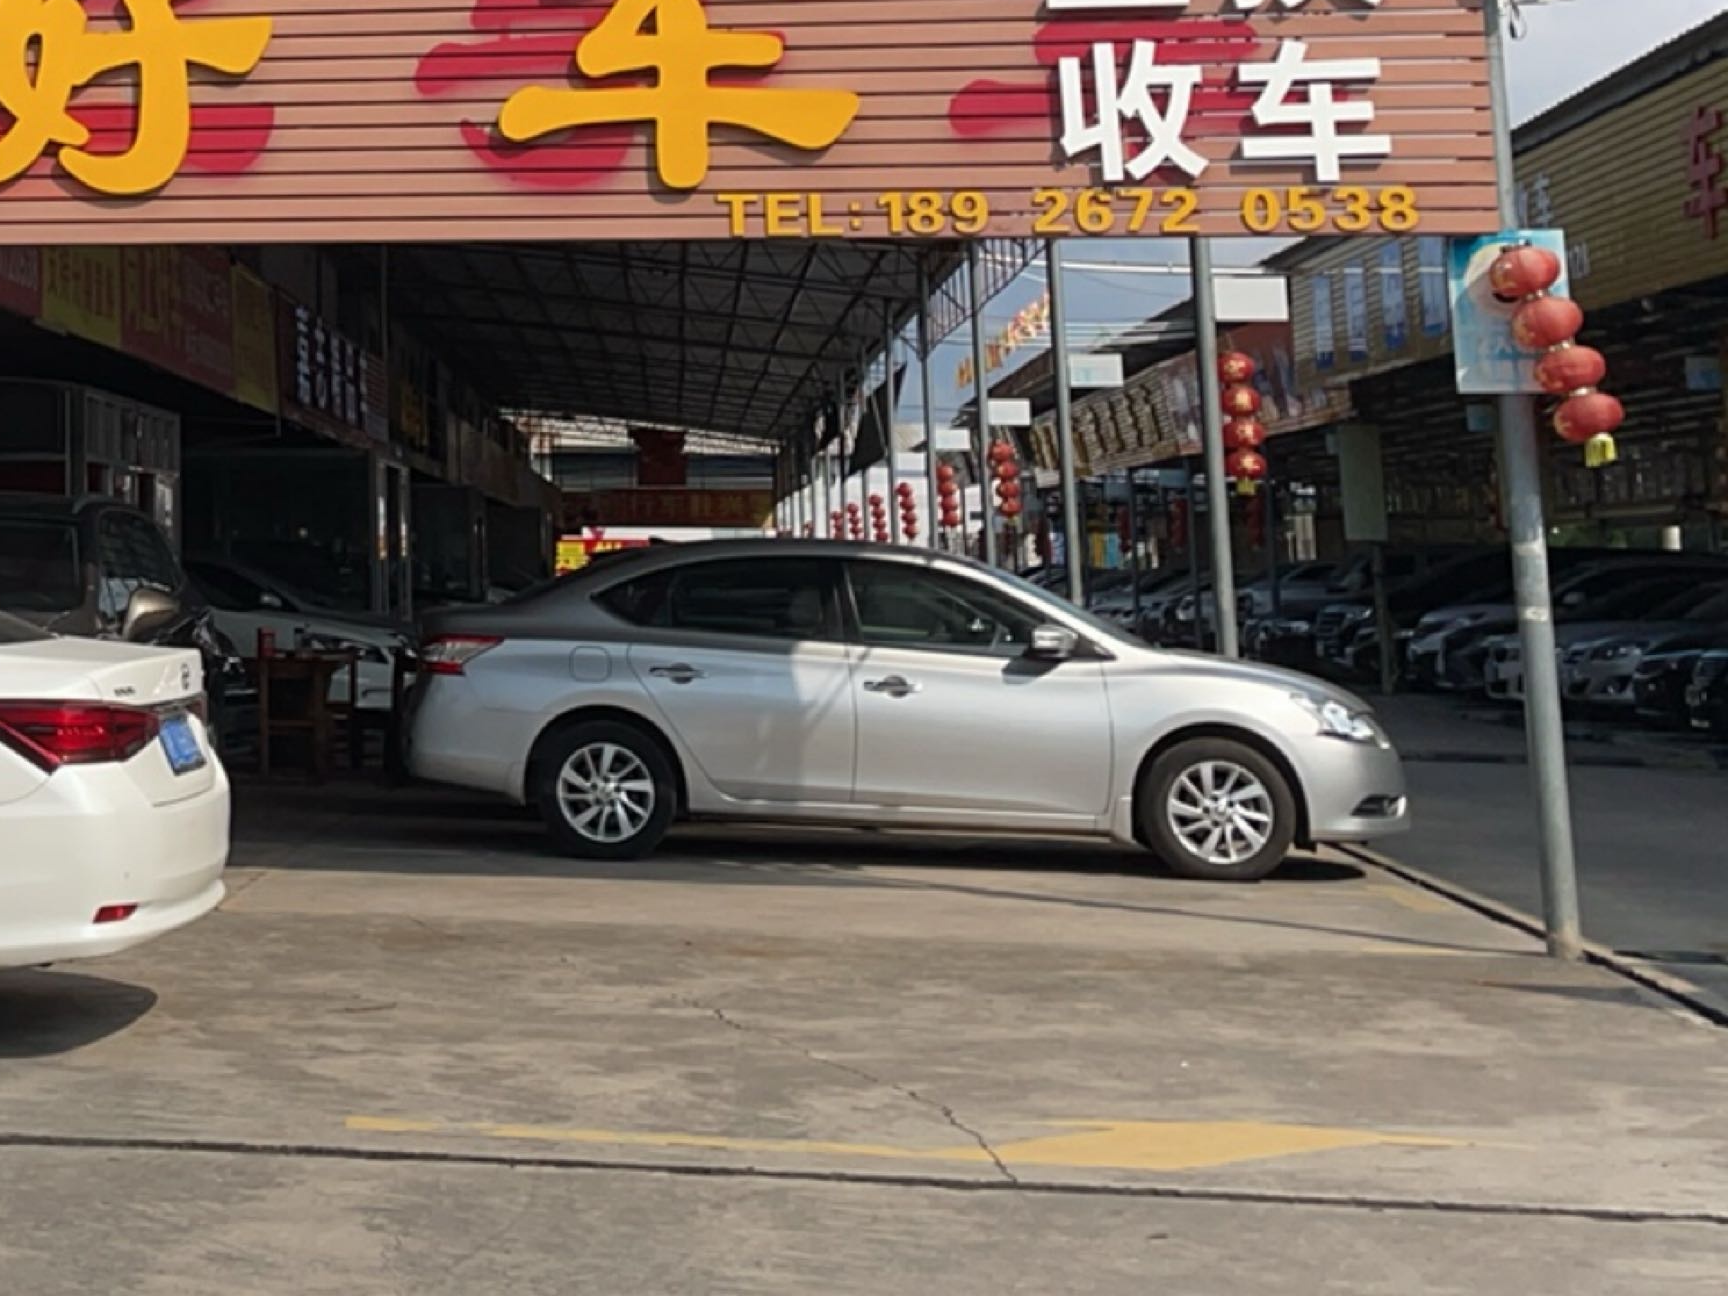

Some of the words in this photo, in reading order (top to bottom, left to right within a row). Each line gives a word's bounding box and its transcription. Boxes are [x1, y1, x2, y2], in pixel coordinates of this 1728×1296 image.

[1059, 39, 1392, 182] 收车
[1032, 187, 1200, 234] 2672
[1240, 184, 1421, 232] 0538
